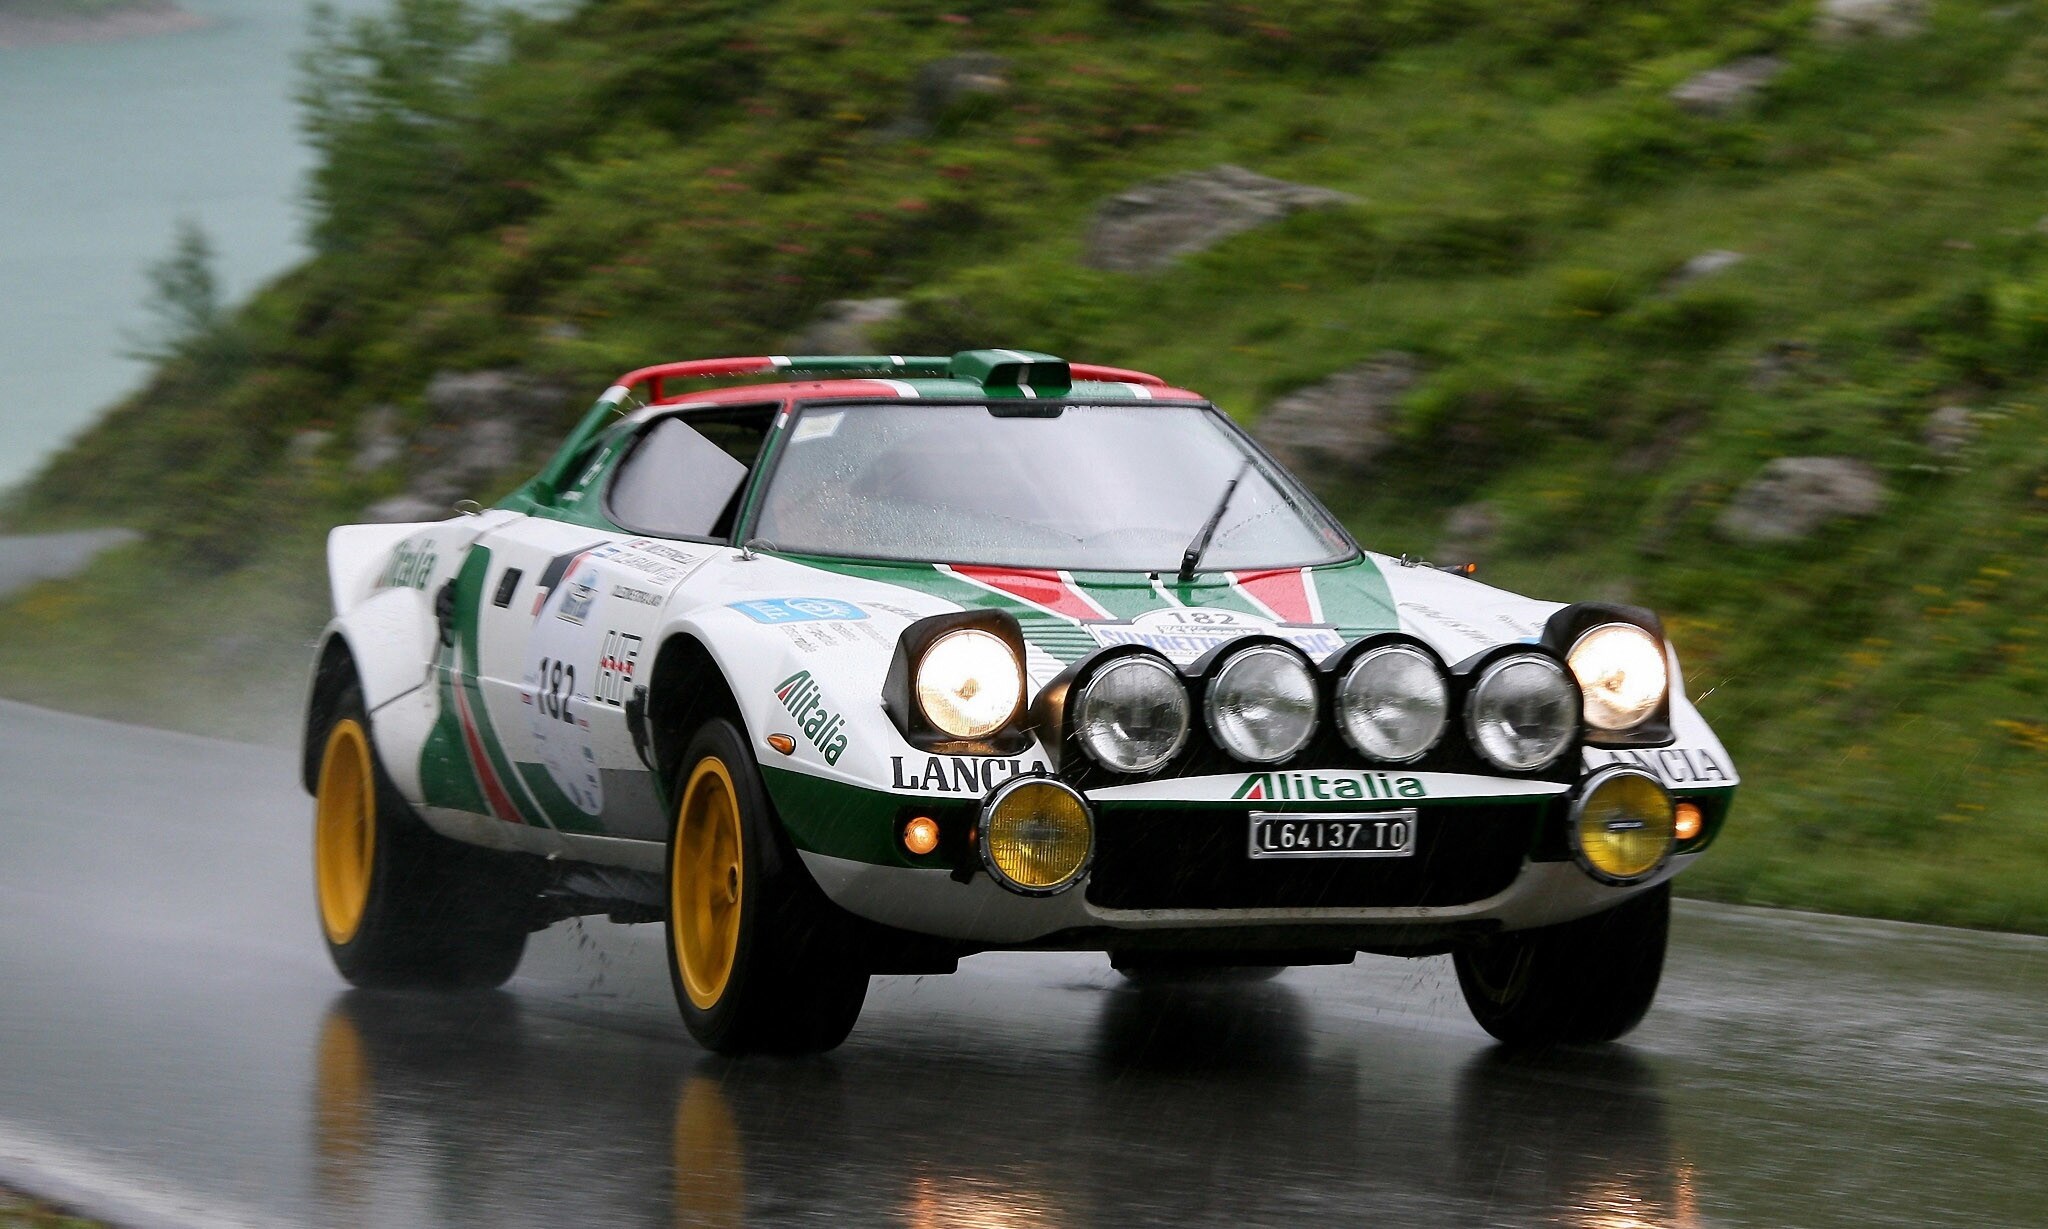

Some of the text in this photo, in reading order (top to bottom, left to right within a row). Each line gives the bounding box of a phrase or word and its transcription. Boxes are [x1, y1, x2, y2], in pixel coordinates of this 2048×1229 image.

[1167, 612, 1241, 625] 182
[537, 656, 575, 725] 182
[774, 669, 848, 767] Alitalia
[1230, 772, 1427, 799] Alitalia
[1263, 822, 1407, 850] L64137 TO
